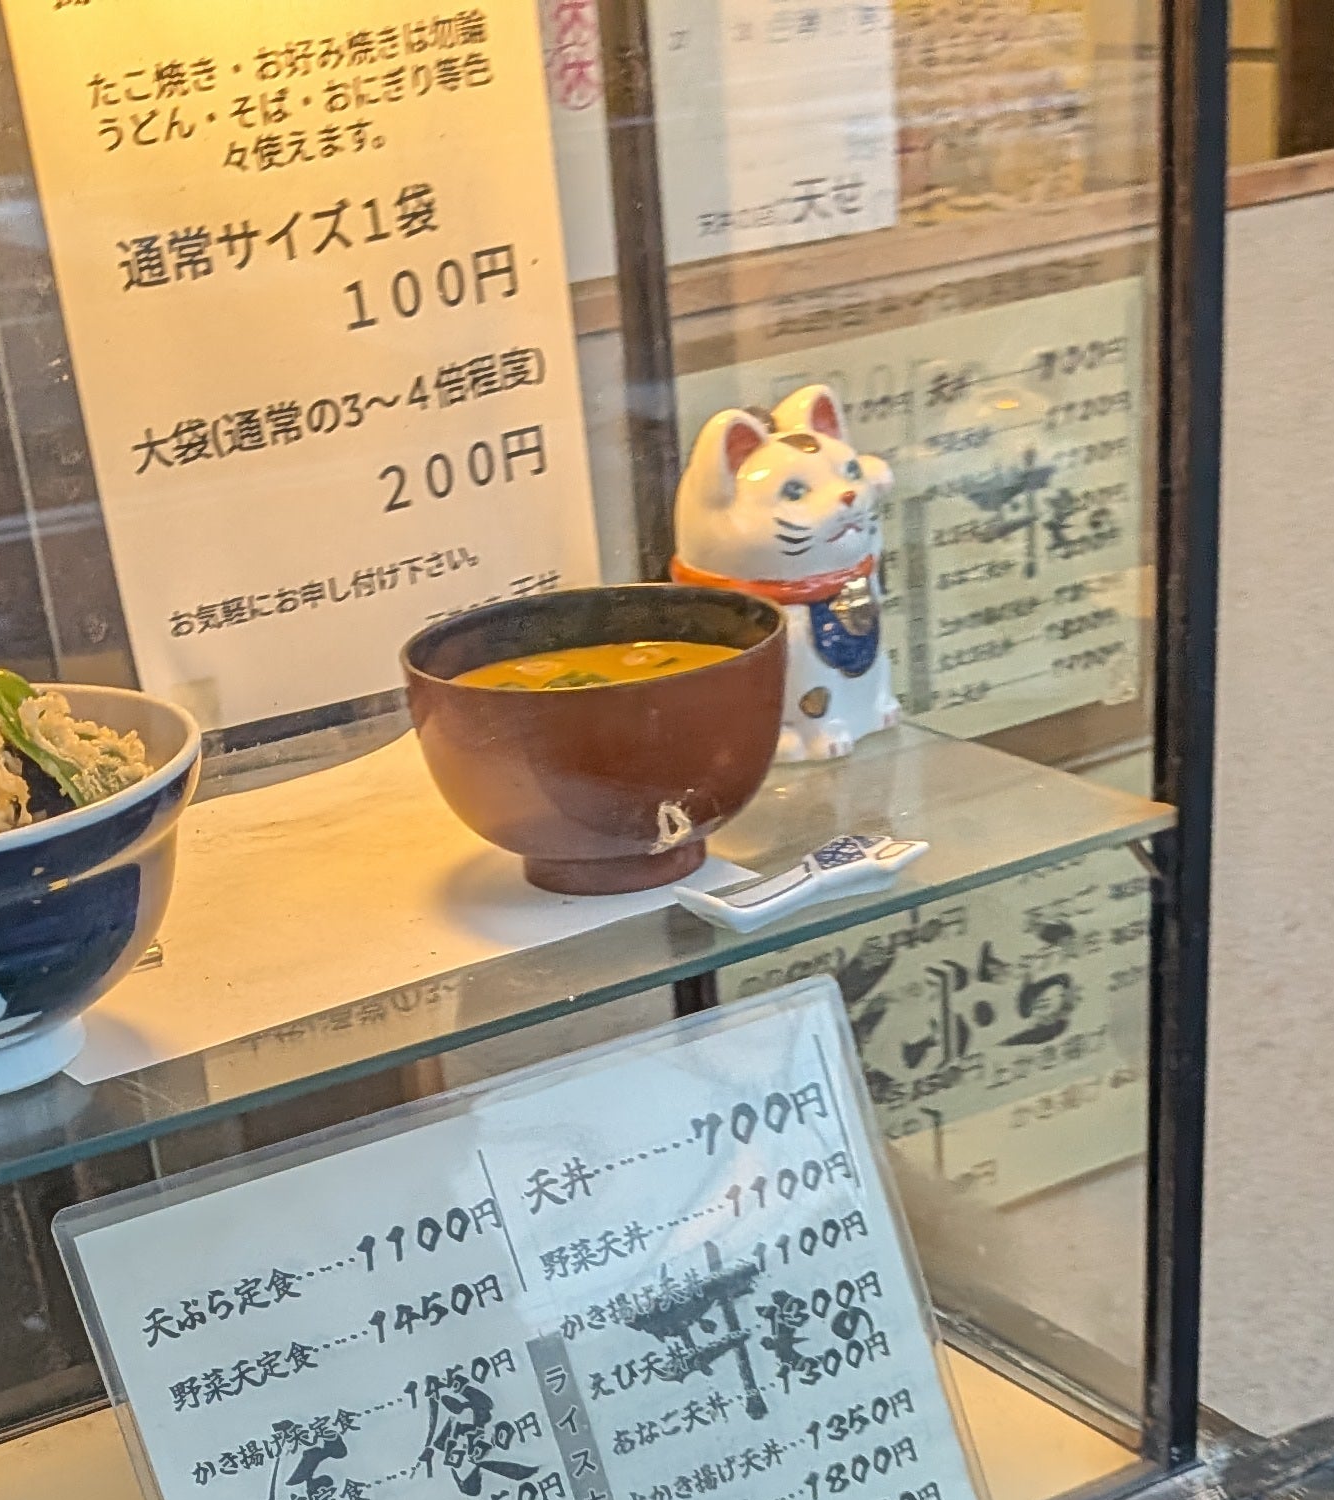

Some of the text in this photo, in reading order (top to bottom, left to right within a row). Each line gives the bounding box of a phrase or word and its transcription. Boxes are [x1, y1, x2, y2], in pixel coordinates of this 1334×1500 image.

[86, 10, 488, 109] たこ焼き・お好み焼きは勿論
[97, 52, 495, 151] うどん・そば・おにぎり等色
[223, 120, 387, 174] 々使えます。
[116, 183, 438, 292] 通常サイズ1袋
[344, 244, 517, 331] 100円
[378, 425, 546, 513] 200円
[168, 547, 479, 637] お気軽にお申し付け下さい。
[523, 1083, 828, 1214] 天丼 700円
[539, 1150, 853, 1283] 野菜天丼 1100円
[753, 1210, 869, 1273] 1100円
[143, 1198, 503, 1348] 天ぷら定食 1100円
[169, 1275, 503, 1411] 野菜天定食 1450円
[777, 1331, 891, 1395] 1300円
[192, 1408, 361, 1485] かき揚げ天定食
[805, 1389, 915, 1450] 1350円
[805, 1437, 919, 1499] 1800円
